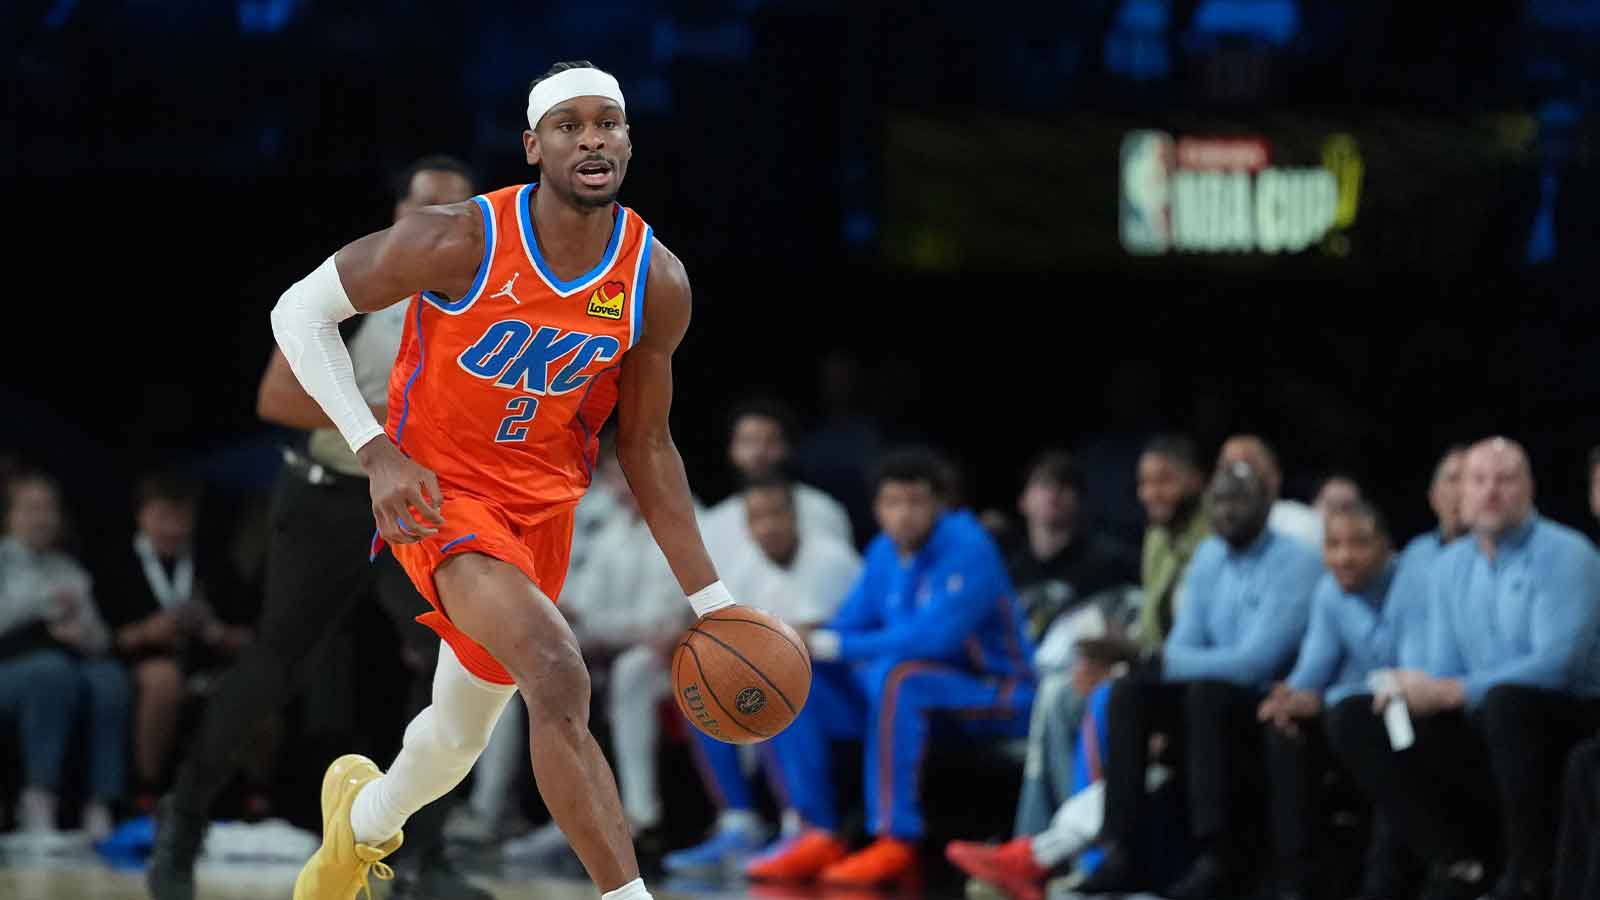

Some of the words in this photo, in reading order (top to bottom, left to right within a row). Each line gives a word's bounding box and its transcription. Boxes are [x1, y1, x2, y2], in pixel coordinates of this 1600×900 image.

[1175, 171, 1253, 252] NBA
[1257, 168, 1337, 254] CUP
[458, 320, 620, 395] OKC
[495, 397, 539, 442] 2
